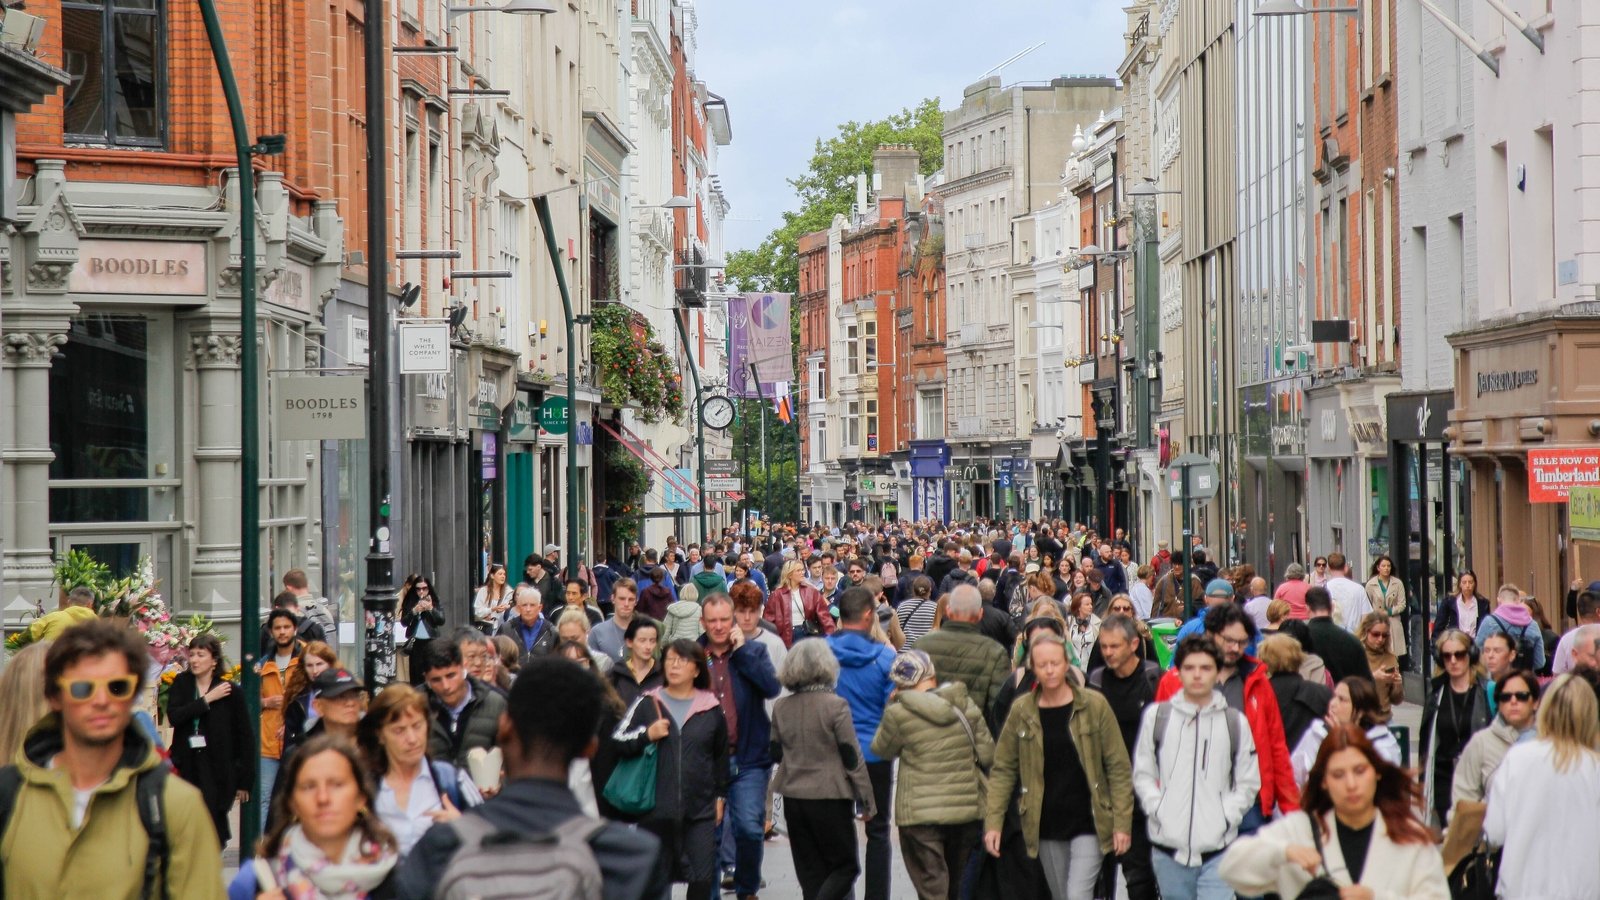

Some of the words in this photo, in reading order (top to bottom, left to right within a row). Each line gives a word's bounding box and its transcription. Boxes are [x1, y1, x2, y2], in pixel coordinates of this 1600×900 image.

[90, 257, 188, 276] BOODLES
[749, 336, 789, 347] KAIZEN
[285, 397, 358, 410] BOODLES
[1533, 457, 1558, 465] SALE
[1560, 457, 1582, 465] NOW
[1533, 467, 1600, 483] Timberland
